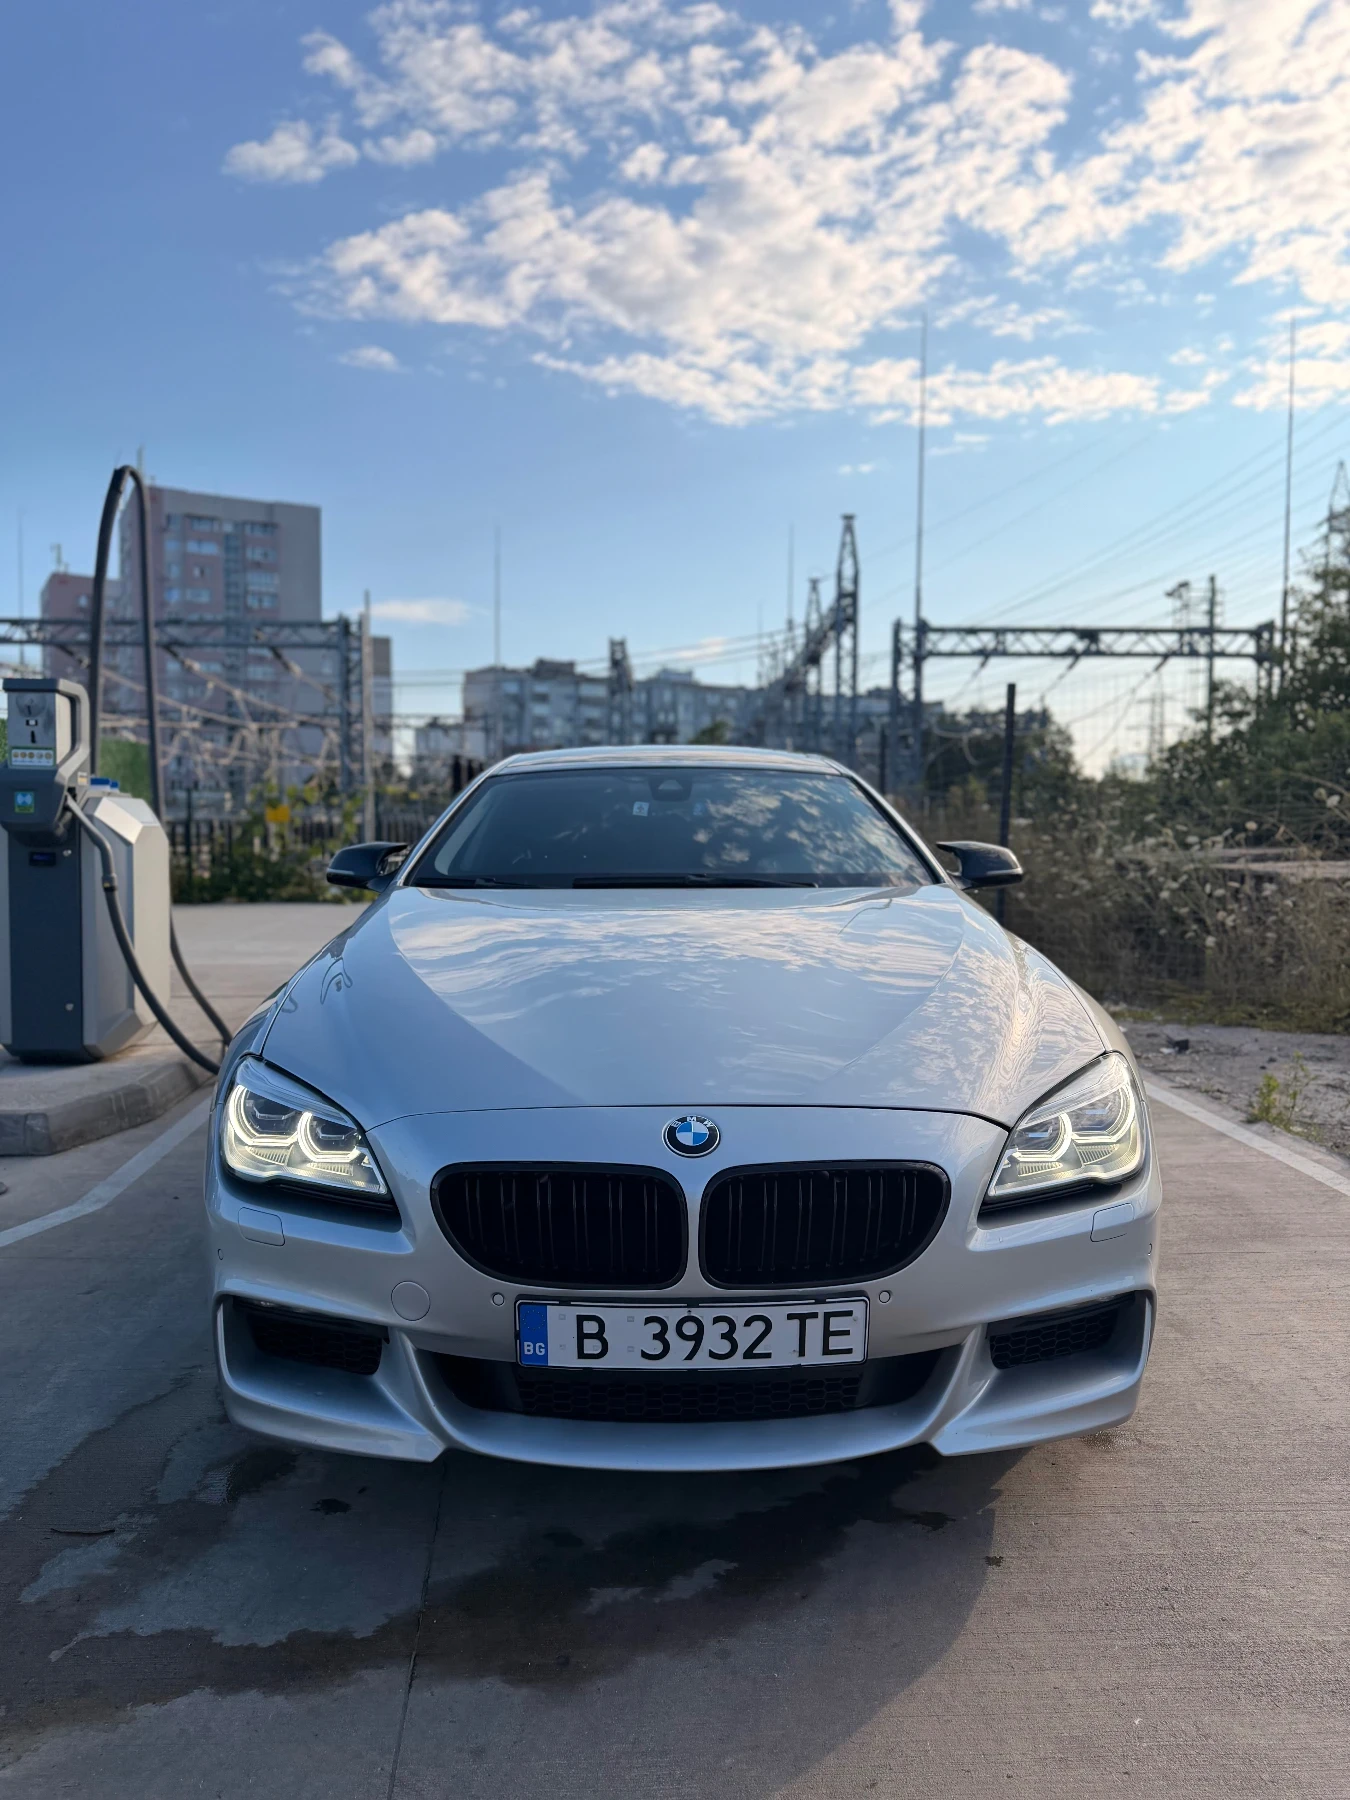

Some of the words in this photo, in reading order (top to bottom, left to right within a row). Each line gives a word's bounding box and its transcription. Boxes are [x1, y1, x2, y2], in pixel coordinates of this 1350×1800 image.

[671, 1116, 714, 1128] BMW
[576, 1314, 608, 1359] B
[640, 1314, 773, 1361] 3932
[786, 1310, 853, 1357] TE
[523, 1341, 545, 1355] BG
